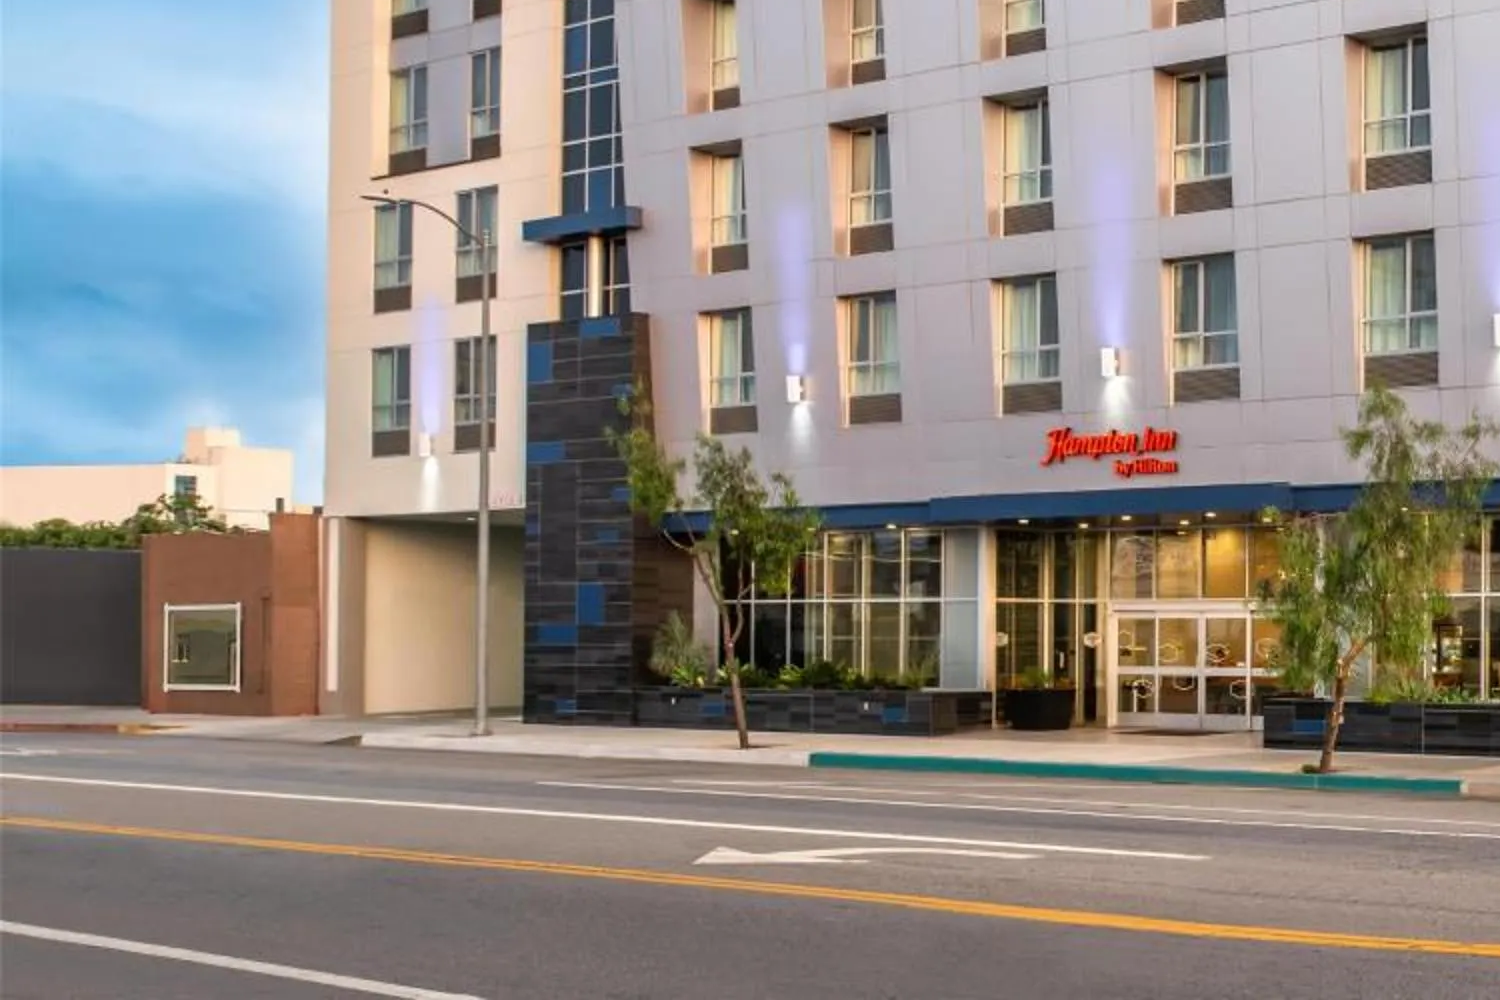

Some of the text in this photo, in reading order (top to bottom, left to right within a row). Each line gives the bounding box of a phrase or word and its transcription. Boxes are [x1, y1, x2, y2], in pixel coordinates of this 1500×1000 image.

[1041, 426, 1177, 465] Hampton Inn
[1114, 458, 1178, 478] by Hilton
